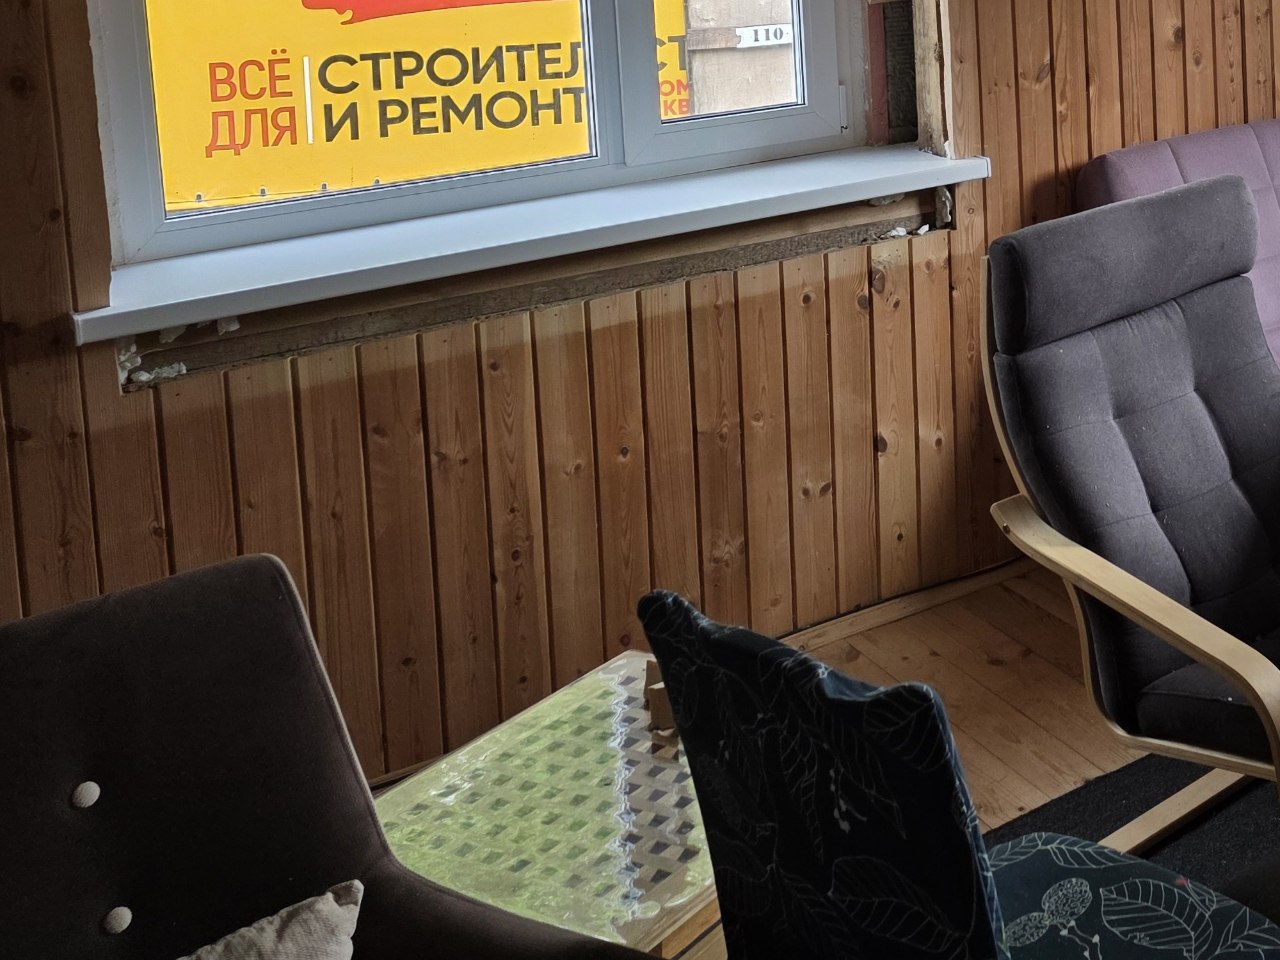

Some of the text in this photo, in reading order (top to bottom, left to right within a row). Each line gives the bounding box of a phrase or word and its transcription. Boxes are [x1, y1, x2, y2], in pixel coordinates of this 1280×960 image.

[752, 27, 784, 42] 110
[208, 48, 294, 103] ВСЁ
[205, 105, 298, 158] ДЛЯ
[323, 86, 585, 142] И РЕМОНТ
